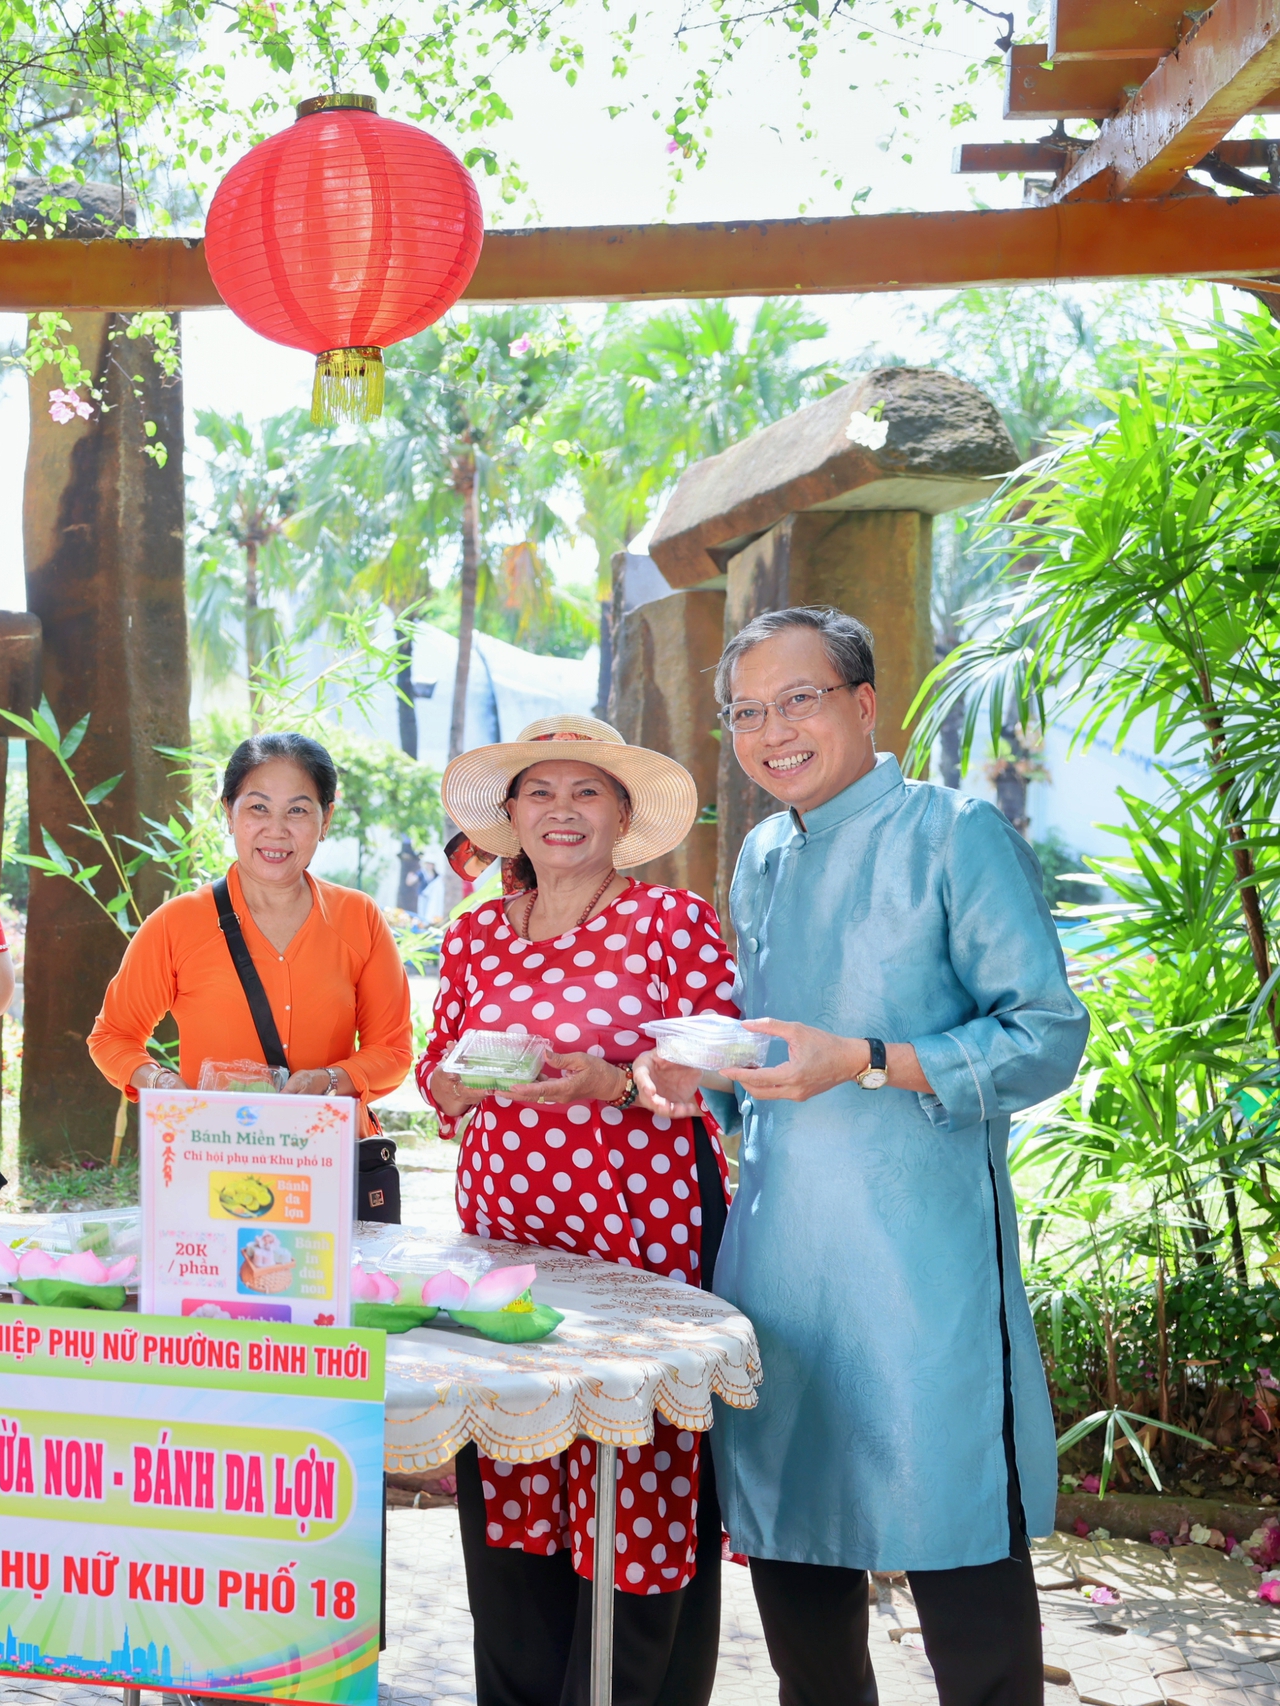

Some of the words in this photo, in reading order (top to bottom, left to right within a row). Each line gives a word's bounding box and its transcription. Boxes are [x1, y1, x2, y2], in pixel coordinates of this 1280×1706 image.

[191, 1129, 231, 1144] Bánh
[236, 1129, 275, 1146] Miền
[279, 1132, 309, 1151] Tây
[183, 1150, 202, 1161] Chi
[206, 1151, 224, 1163] hội
[226, 1152, 249, 1165] phụ
[270, 1155, 294, 1165] Khu
[321, 1157, 333, 1168] 18
[277, 1179, 309, 1192] Bánh
[285, 1193, 300, 1205] da
[175, 1242, 208, 1257] 20K
[295, 1236, 330, 1250] Bánh
[305, 1251, 319, 1264] in
[179, 1257, 219, 1278] phần
[300, 1284, 326, 1294] non
[49, 1328, 95, 1365] PHỤ
[103, 1328, 138, 1362] NỮ
[143, 1332, 240, 1370] PHƯỜNG
[248, 1337, 306, 1374] BÌNH
[314, 1343, 368, 1379] THỚI
[44, 1438, 104, 1500] NON
[133, 1431, 215, 1509] BÁNH
[225, 1453, 264, 1513] DA
[274, 1447, 335, 1534] LỢN
[63, 1550, 120, 1597] NỮ
[128, 1561, 204, 1606] KHU
[218, 1561, 298, 1614] PHỐ
[310, 1578, 356, 1620] 18
